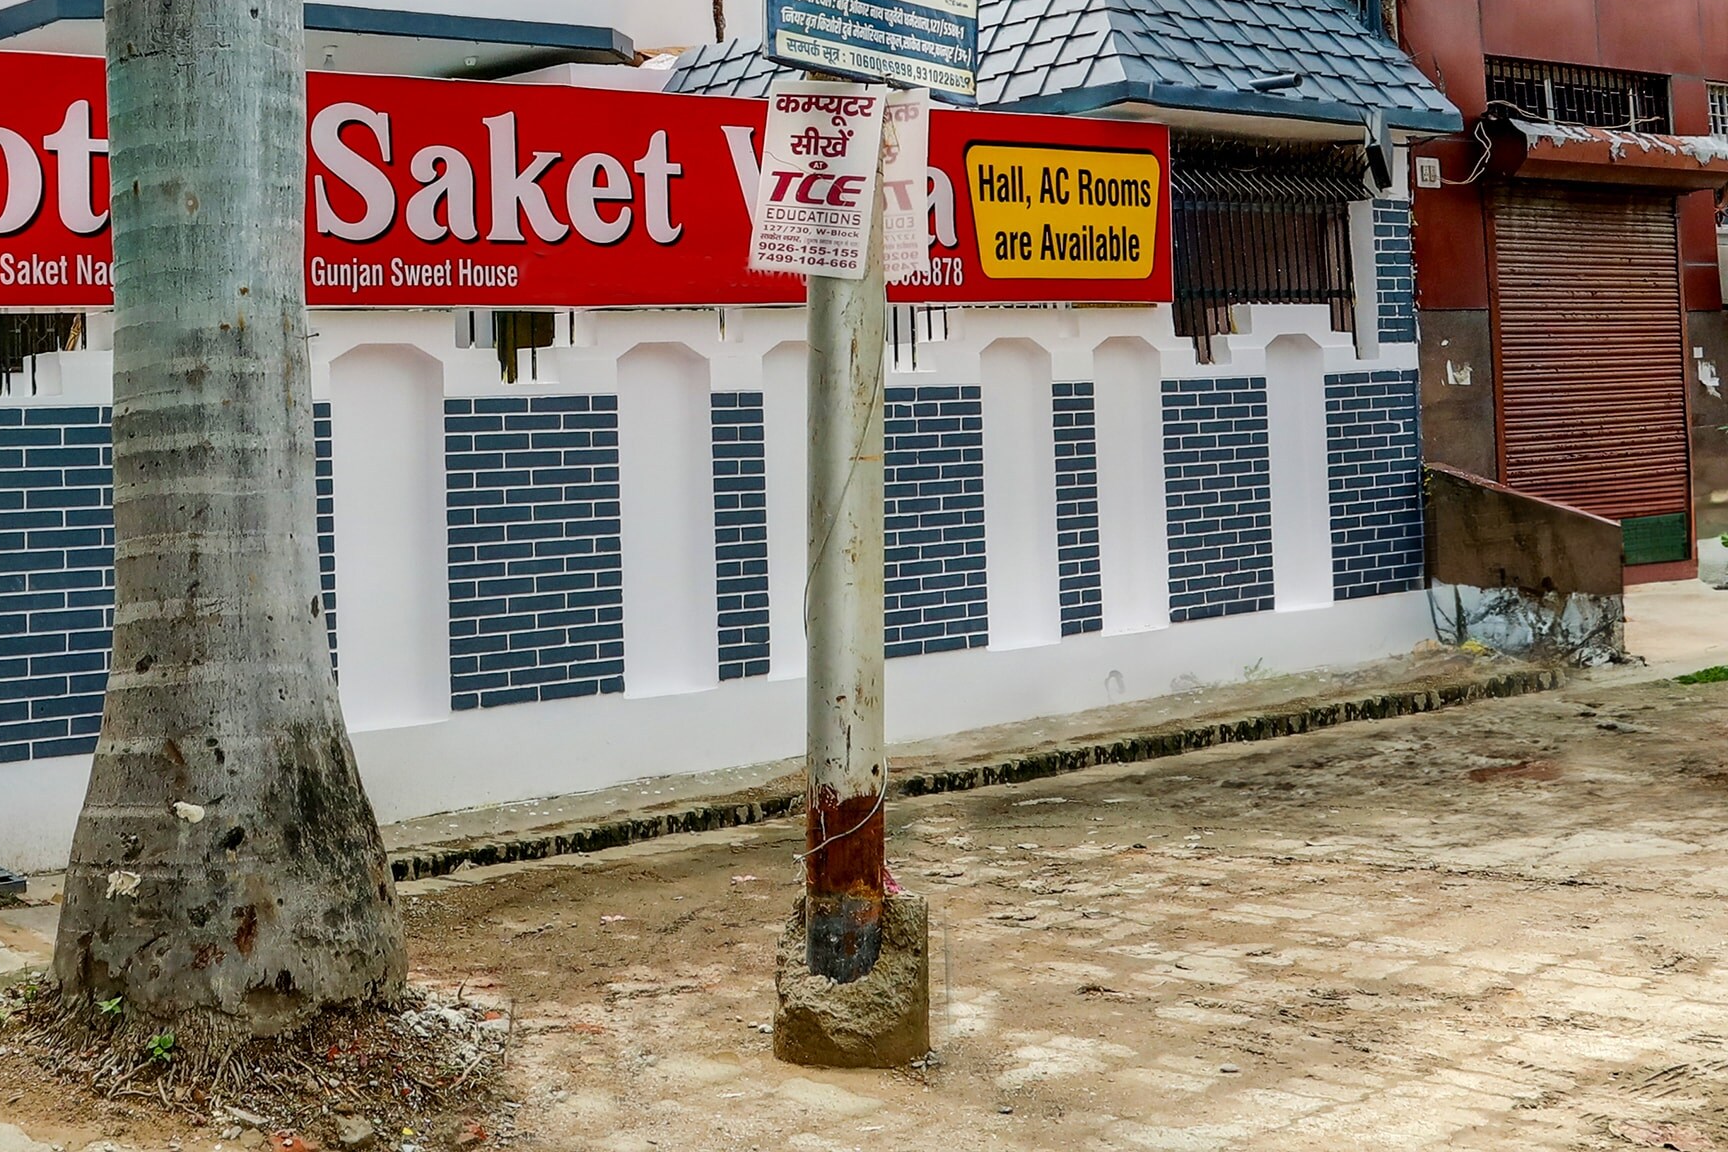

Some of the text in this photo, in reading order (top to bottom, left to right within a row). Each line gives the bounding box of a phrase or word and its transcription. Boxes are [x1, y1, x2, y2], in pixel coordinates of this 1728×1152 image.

[870, 5, 884, 21] नाथ
[786, 37, 820, 58] सम्पर्क
[776, 94, 876, 126] कम्प्यूटर
[790, 127, 854, 157] सीखें
[310, 102, 683, 245] Saket
[813, 161, 823, 169] AT
[768, 171, 867, 207] TCE
[978, 164, 1030, 210] Hall,
[1039, 167, 1069, 205] AC
[1078, 169, 1151, 208] Rooms
[766, 207, 861, 226] EDUCATIONS
[763, 224, 859, 238] 127/730, W-Block
[995, 223, 1140, 263] are Available
[758, 252, 857, 269] 7499-104-666
[759, 241, 858, 258] 9026-155-155
[0, 252, 68, 286] Saket
[310, 256, 385, 294] Gunjan
[390, 257, 452, 287] Sweet
[458, 258, 518, 287] House
